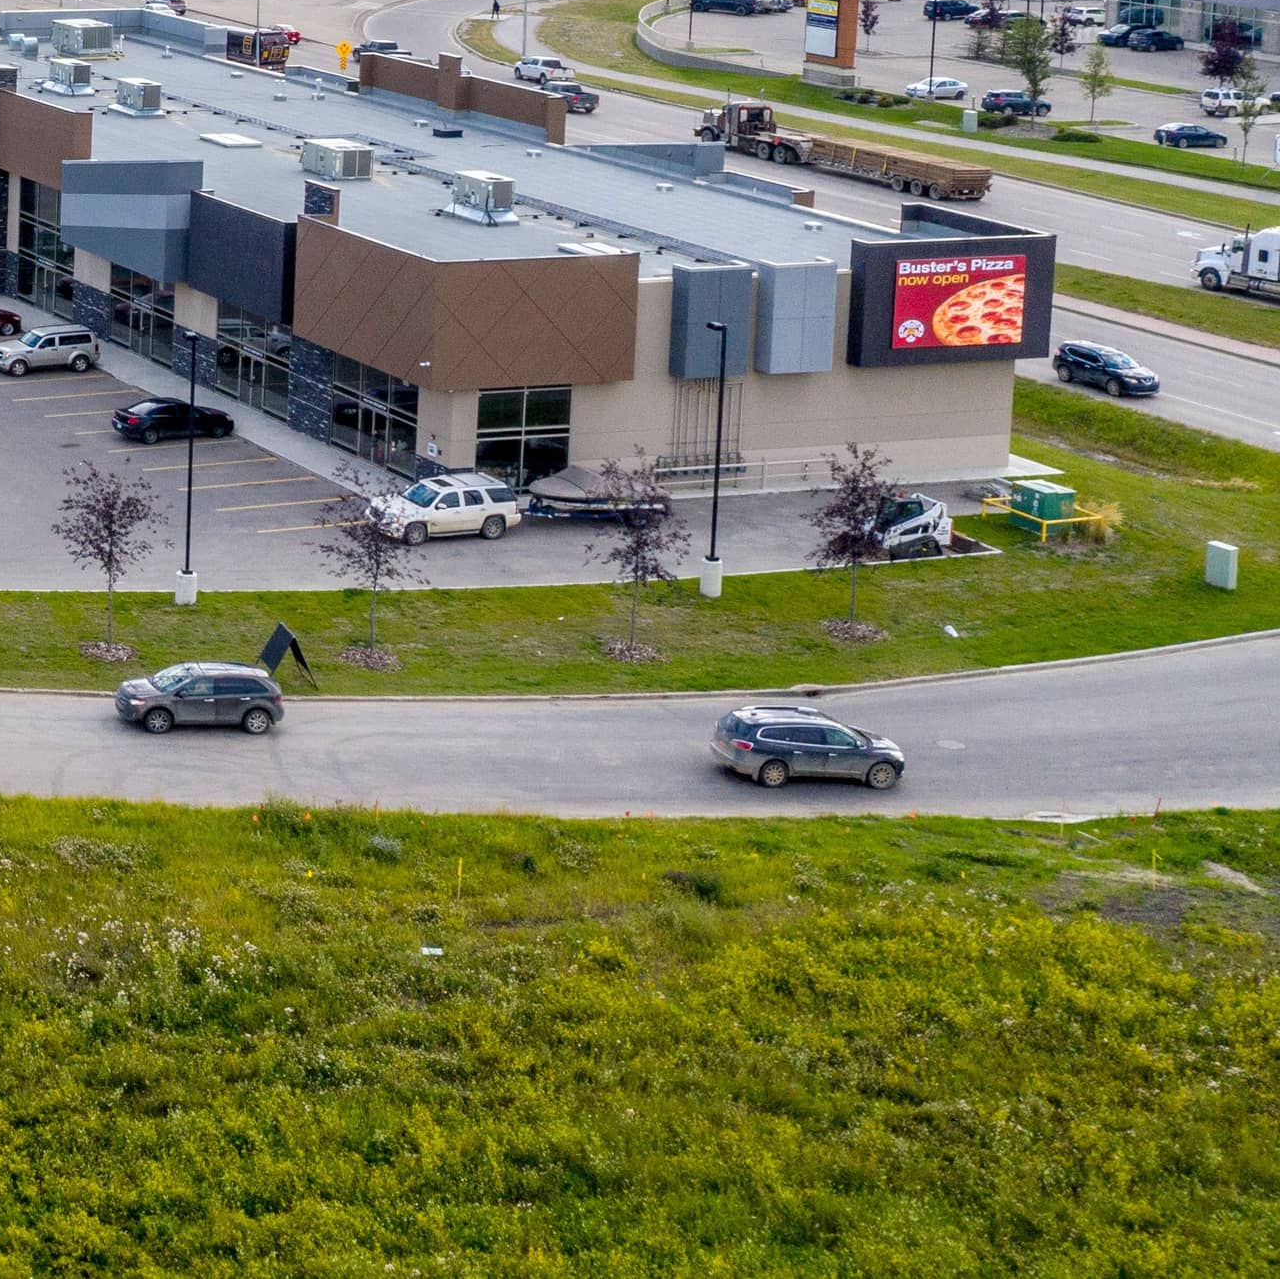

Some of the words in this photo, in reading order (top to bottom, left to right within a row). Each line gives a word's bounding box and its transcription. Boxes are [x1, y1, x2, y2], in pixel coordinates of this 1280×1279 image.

[899, 261, 967, 275] Buster's
[971, 259, 1014, 272] Pizza
[898, 275, 929, 286] now
[933, 273, 969, 287] open
